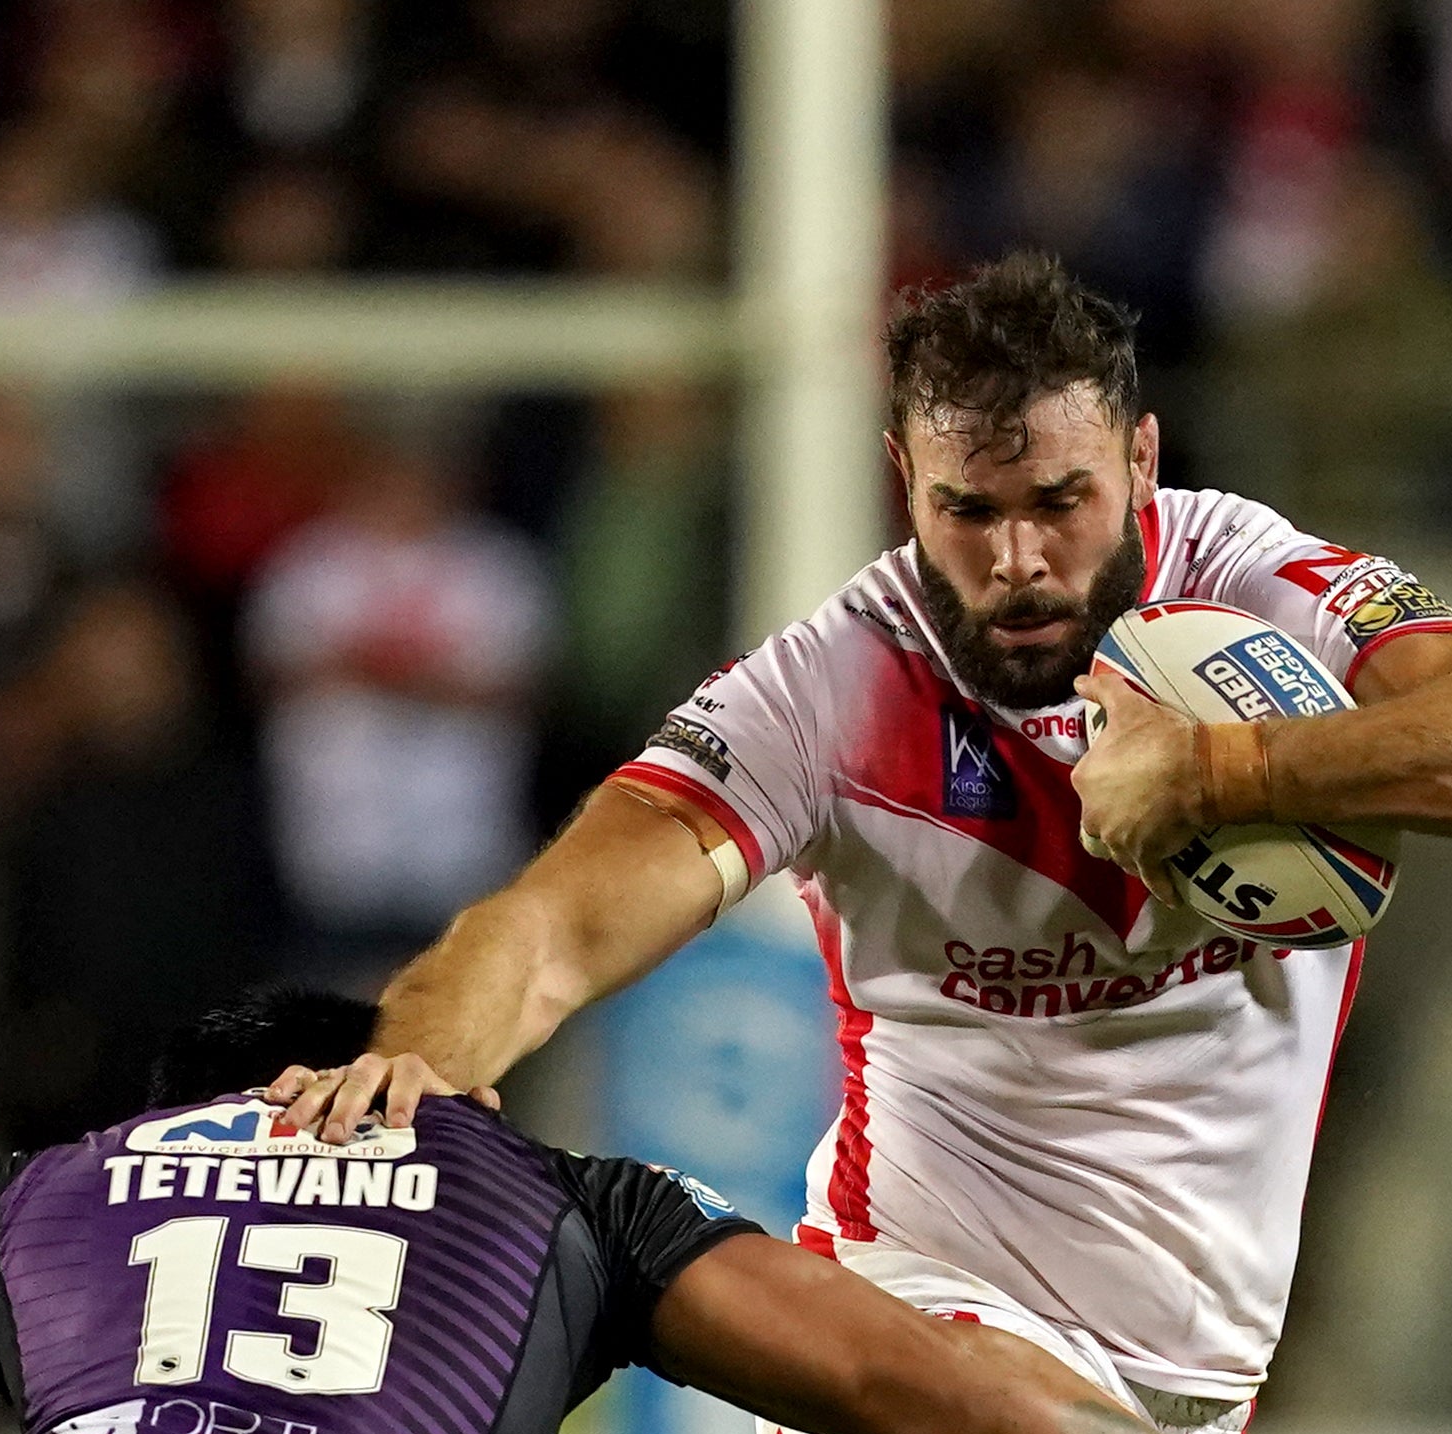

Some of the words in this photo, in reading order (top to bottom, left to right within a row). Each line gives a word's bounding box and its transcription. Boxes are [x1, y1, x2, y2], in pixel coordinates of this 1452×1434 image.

[1204, 659, 1273, 723] RED
[1244, 641, 1323, 718] SUPER
[1261, 634, 1335, 711] LEAGUE
[944, 932, 1097, 981] cash
[104, 1153, 439, 1212] TETEVANO
[127, 1216, 408, 1395] 13
